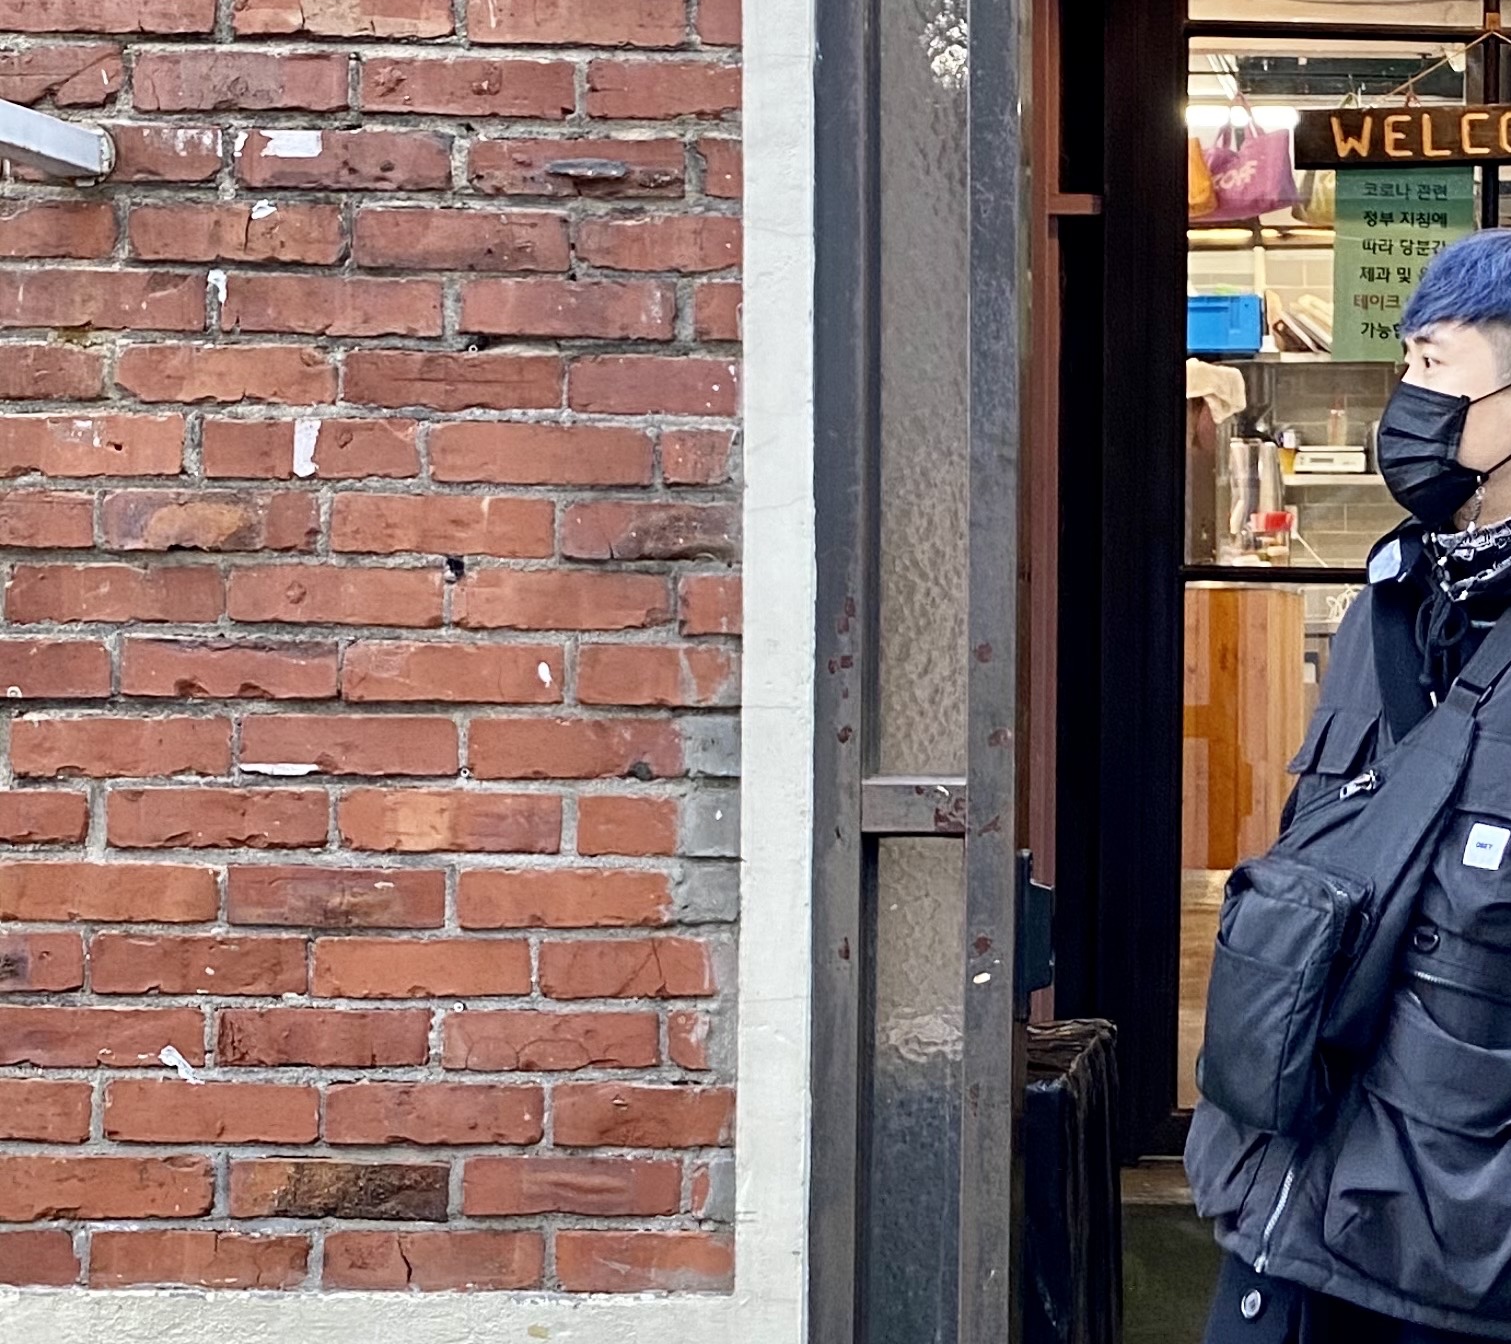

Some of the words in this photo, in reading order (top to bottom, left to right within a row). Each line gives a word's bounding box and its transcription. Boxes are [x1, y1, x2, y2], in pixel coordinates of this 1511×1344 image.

[1362, 182, 1411, 200] 코로나
[1417, 184, 1448, 201] 관련
[1363, 210, 1394, 227] 정부
[1400, 211, 1448, 228] 지침에
[1362, 238, 1394, 255] 따라
[1360, 266, 1390, 283] 제과
[1397, 267, 1411, 284] 및
